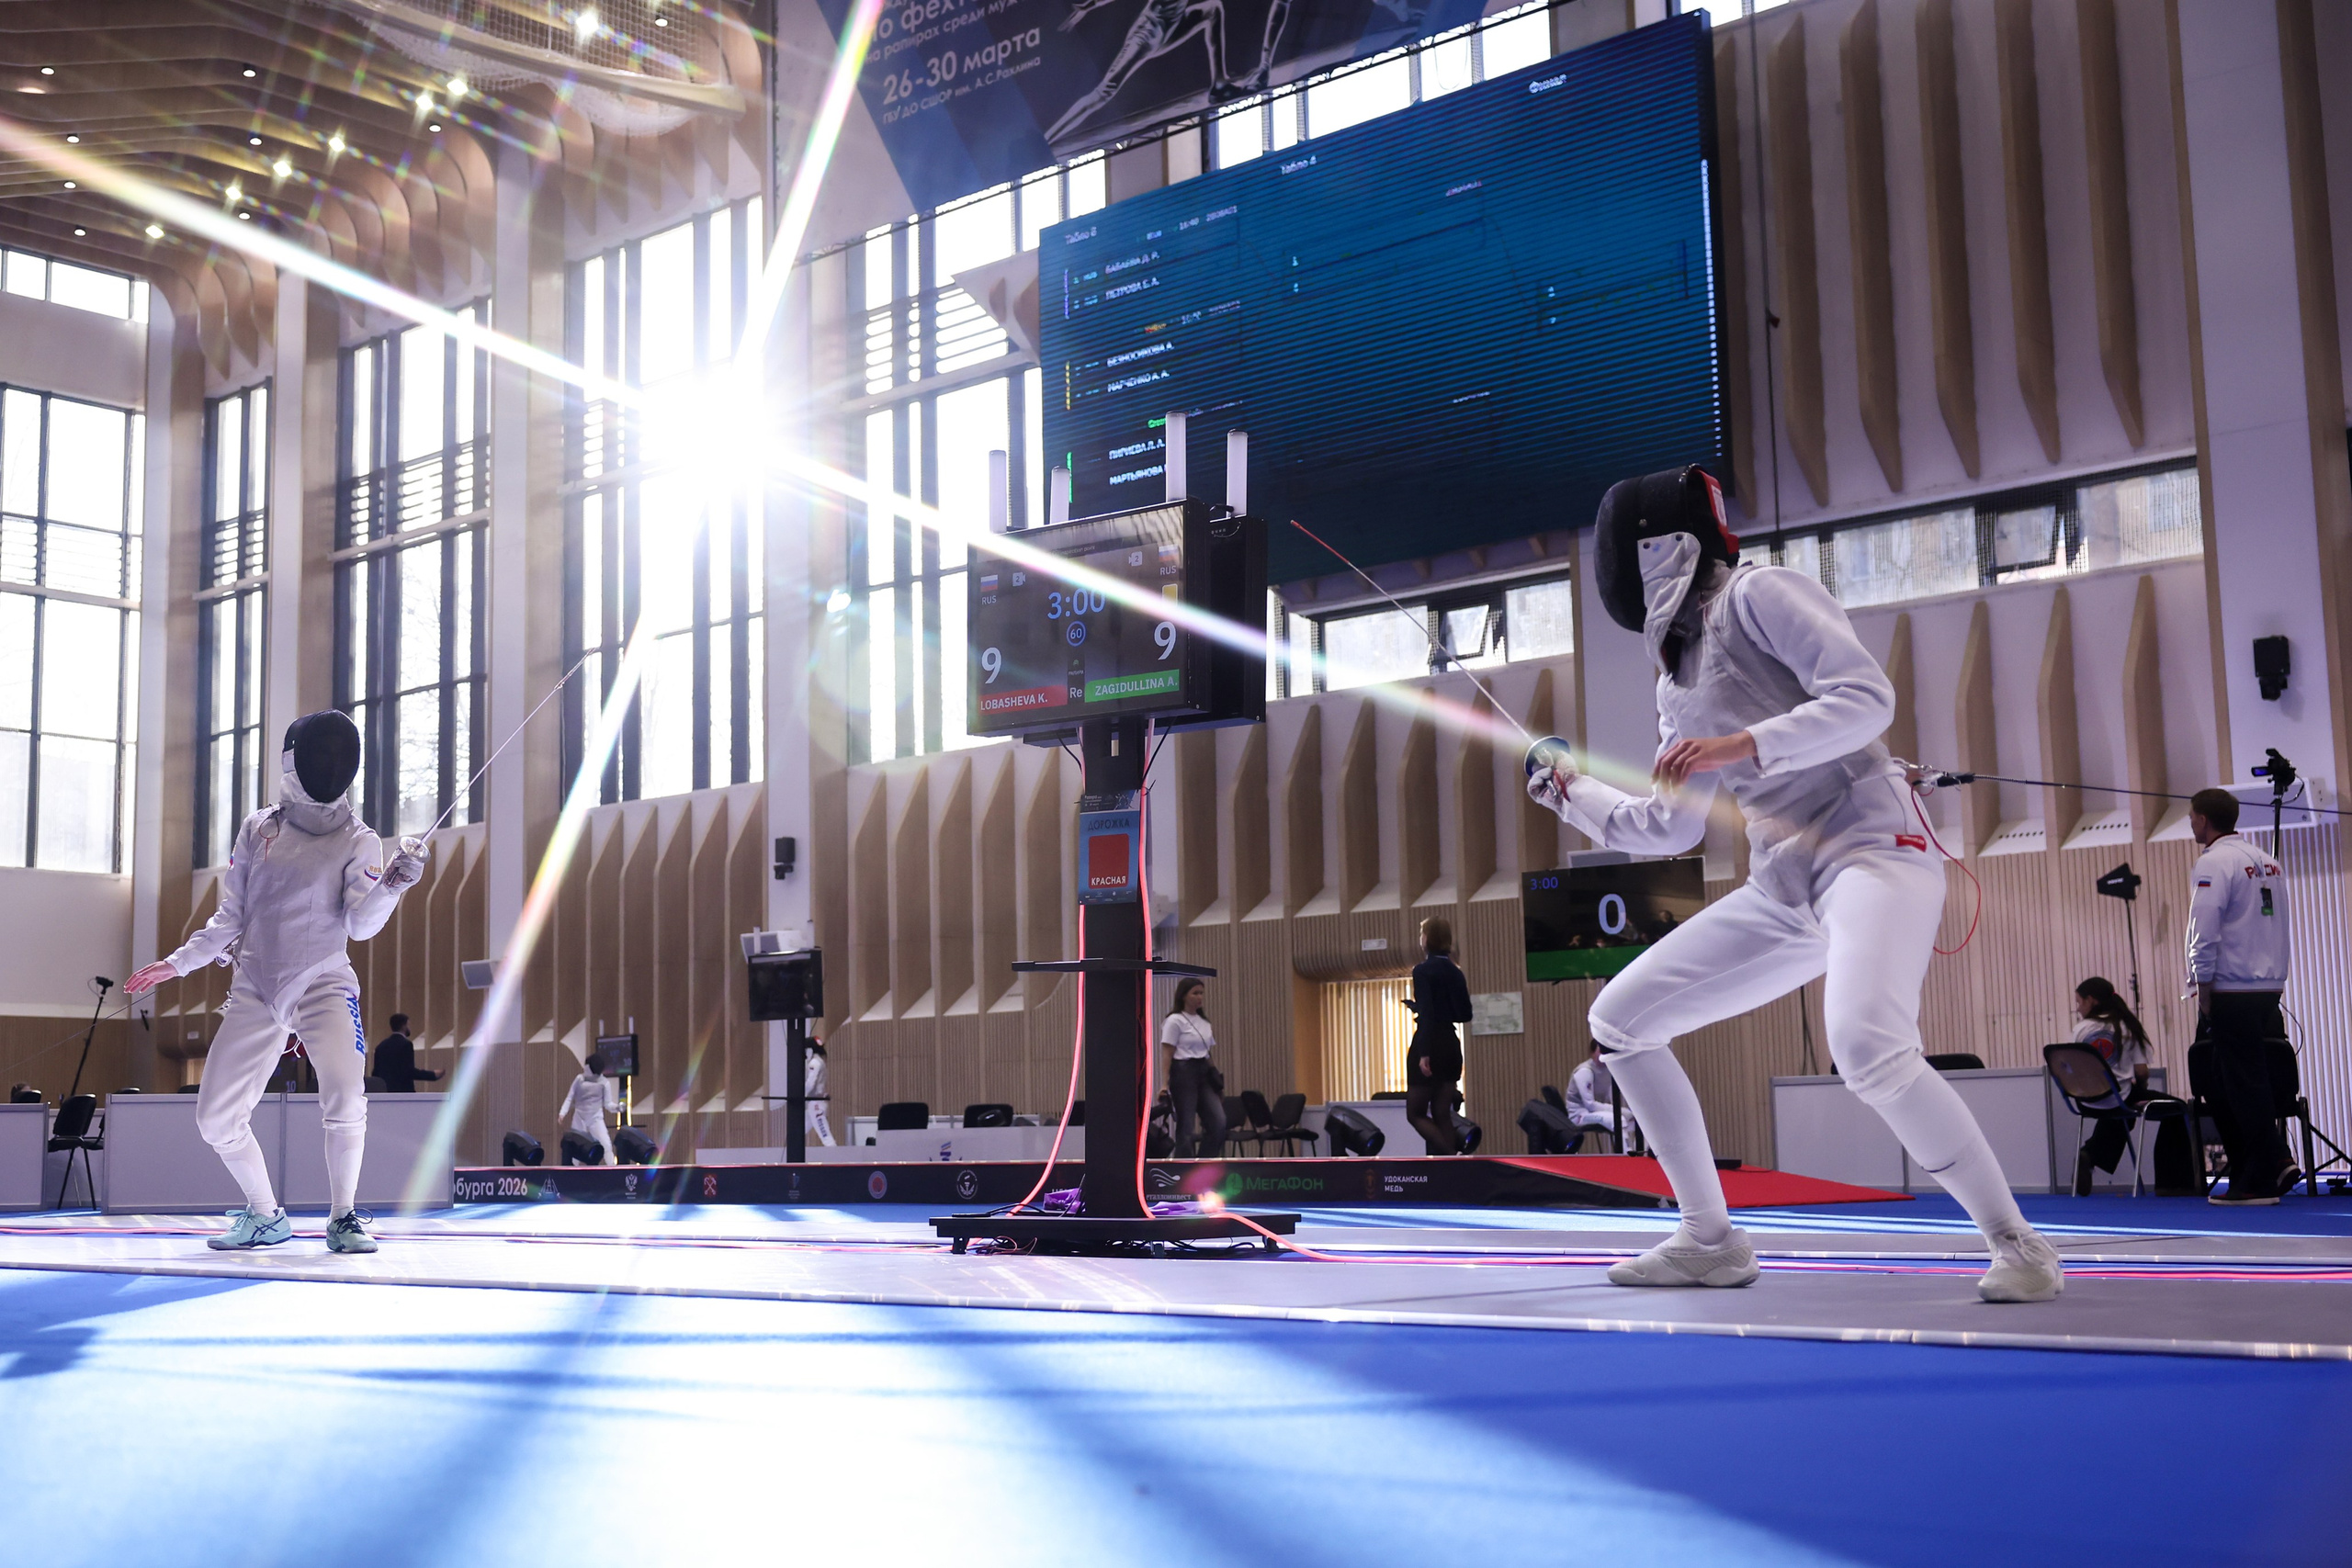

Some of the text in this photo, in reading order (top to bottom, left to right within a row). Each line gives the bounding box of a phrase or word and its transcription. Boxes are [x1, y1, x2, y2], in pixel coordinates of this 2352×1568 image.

[872, 17, 894, 42] о
[884, 25, 940, 61] рапирах
[943, 7, 985, 33] среди
[964, 27, 1041, 73] марта
[902, 102, 919, 118] ДО
[921, 88, 953, 110] СШОР
[1109, 465, 1163, 486] МАРТЬЯНОВА
[1159, 565, 1177, 576] RUS
[981, 594, 997, 605] RUS
[1047, 588, 1105, 620] 3:00
[1069, 627, 1082, 639] 60
[1154, 621, 1177, 660] 9
[981, 647, 1002, 684] 9
[1069, 687, 1083, 698] Re
[1095, 676, 1178, 696] ZAGIDULLINA A.
[980, 693, 1048, 711] LOBASHEVA K.
[1088, 818, 1130, 832] ДОРОЖКА
[1091, 875, 1126, 886] КРАСНАЯ
[1530, 876, 1559, 890] 3:00
[1598, 893, 1627, 935] 0
[345, 997, 366, 1055] RUSSIA
[453, 1177, 528, 1201] бурга 2026
[1384, 1175, 1429, 1183] УДОКАНСКАЯ
